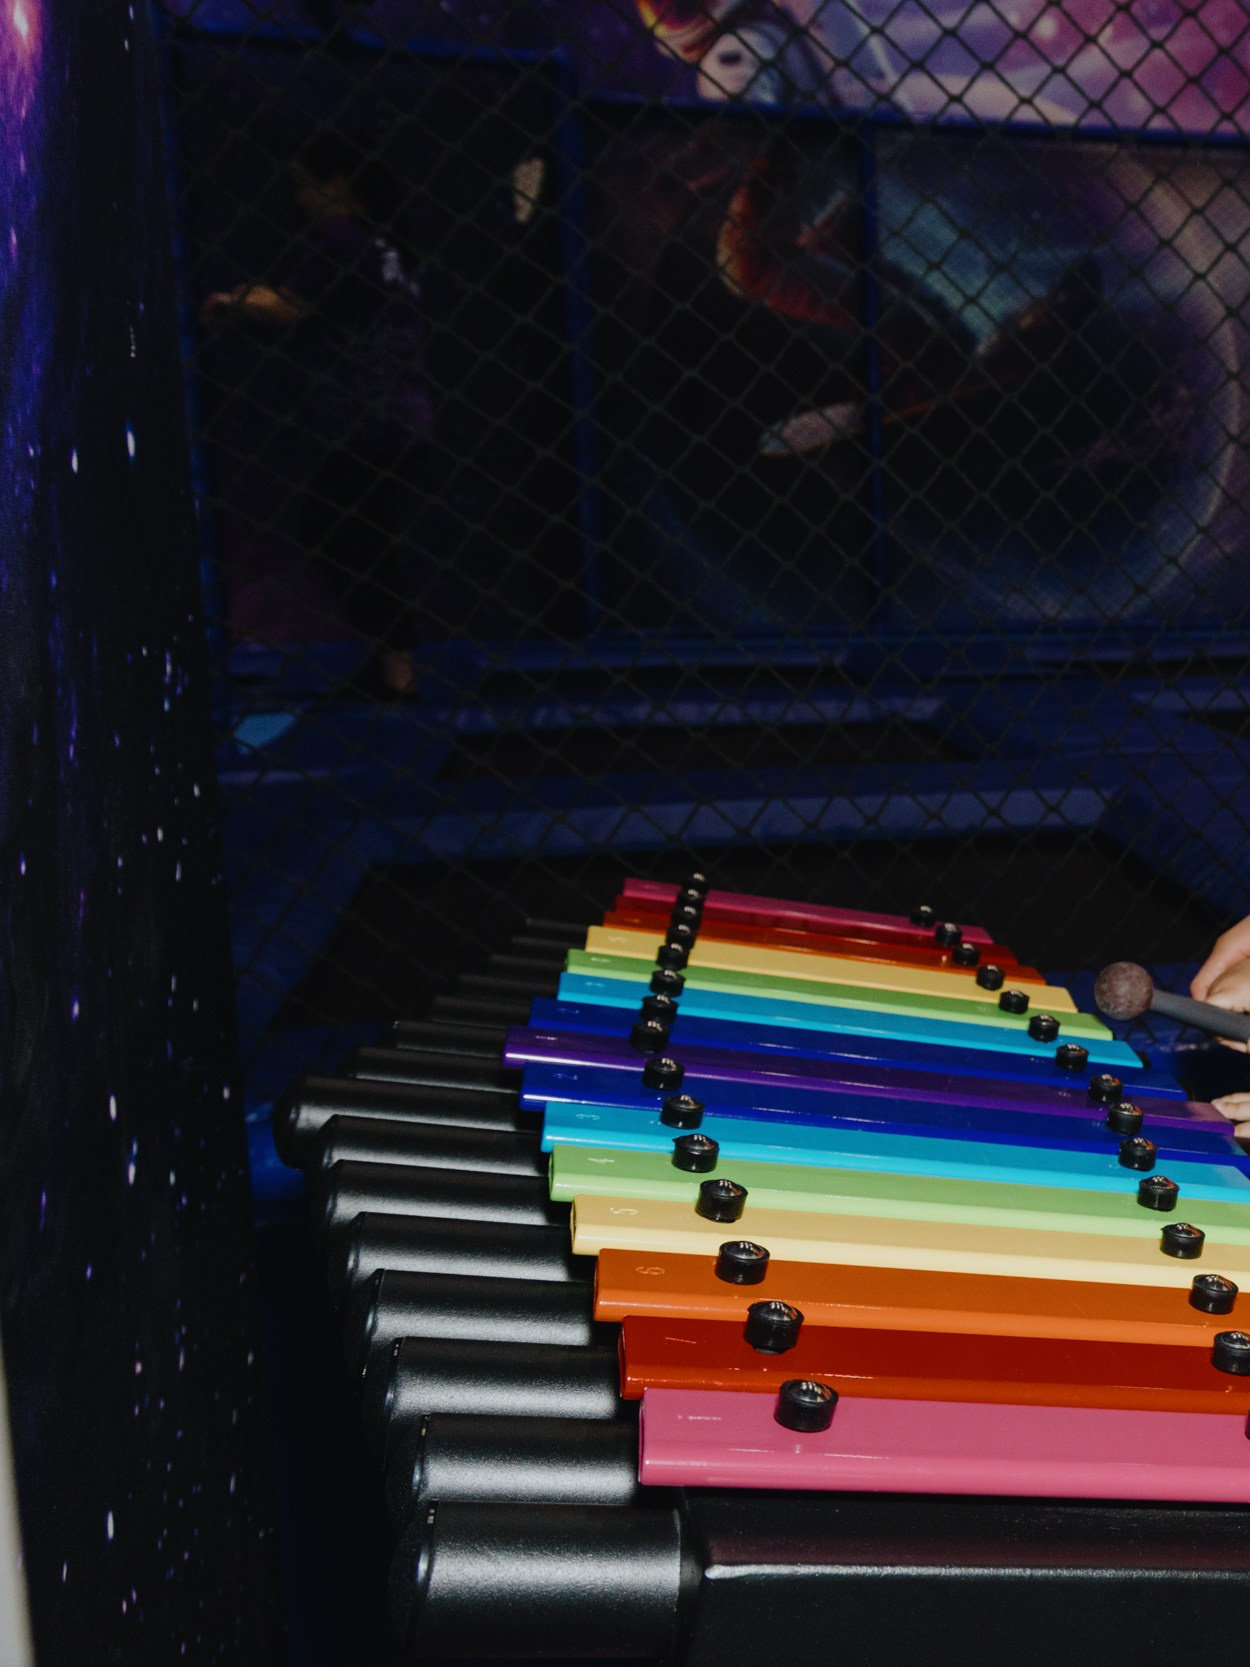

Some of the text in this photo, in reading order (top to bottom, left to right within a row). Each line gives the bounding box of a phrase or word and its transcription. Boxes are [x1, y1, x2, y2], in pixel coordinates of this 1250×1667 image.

[575, 1112, 601, 1122] 3
[587, 1156, 616, 1165] 4
[609, 1206, 639, 1216] 5
[635, 1265, 666, 1276] 6
